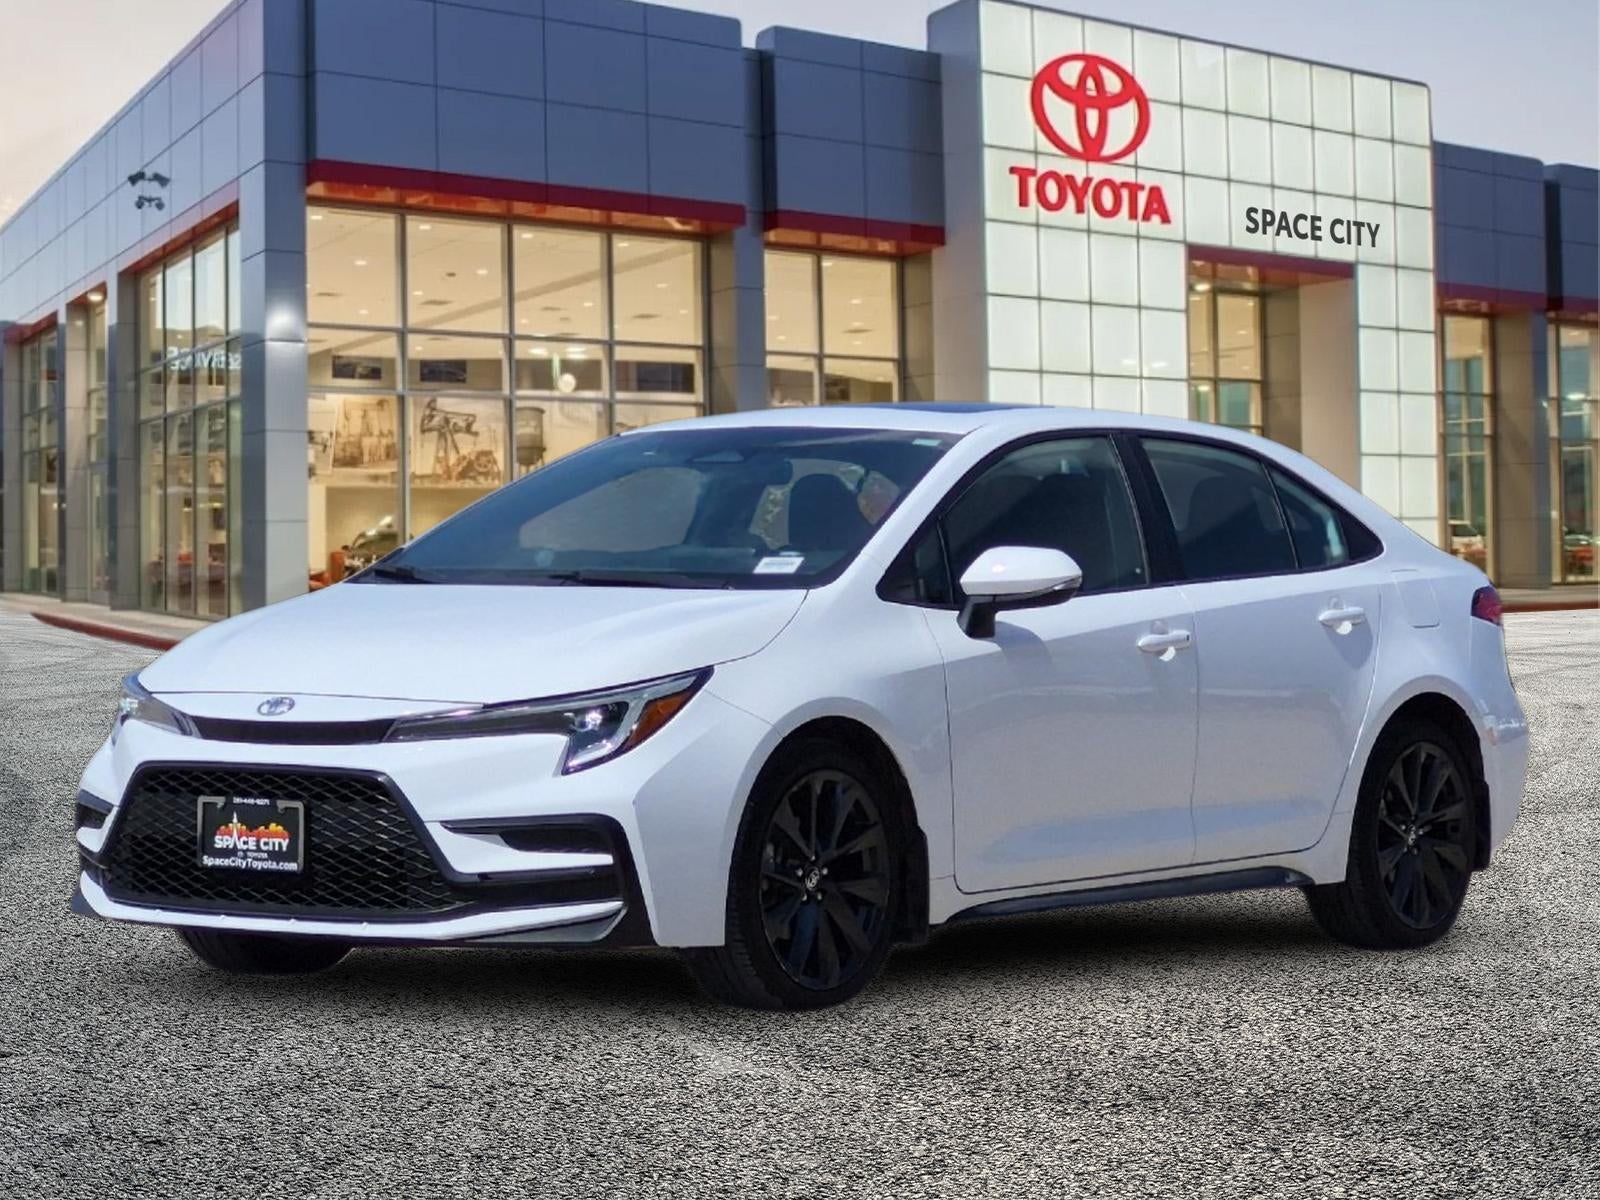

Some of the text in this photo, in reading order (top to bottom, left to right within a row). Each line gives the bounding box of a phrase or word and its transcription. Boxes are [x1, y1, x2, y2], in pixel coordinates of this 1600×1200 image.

[1009, 166, 1171, 224] TOYOTA
[1245, 206, 1381, 248] SPACE CITY
[213, 835, 290, 852] SPACE CITY
[202, 855, 298, 871] SpaceCityToyota.com
